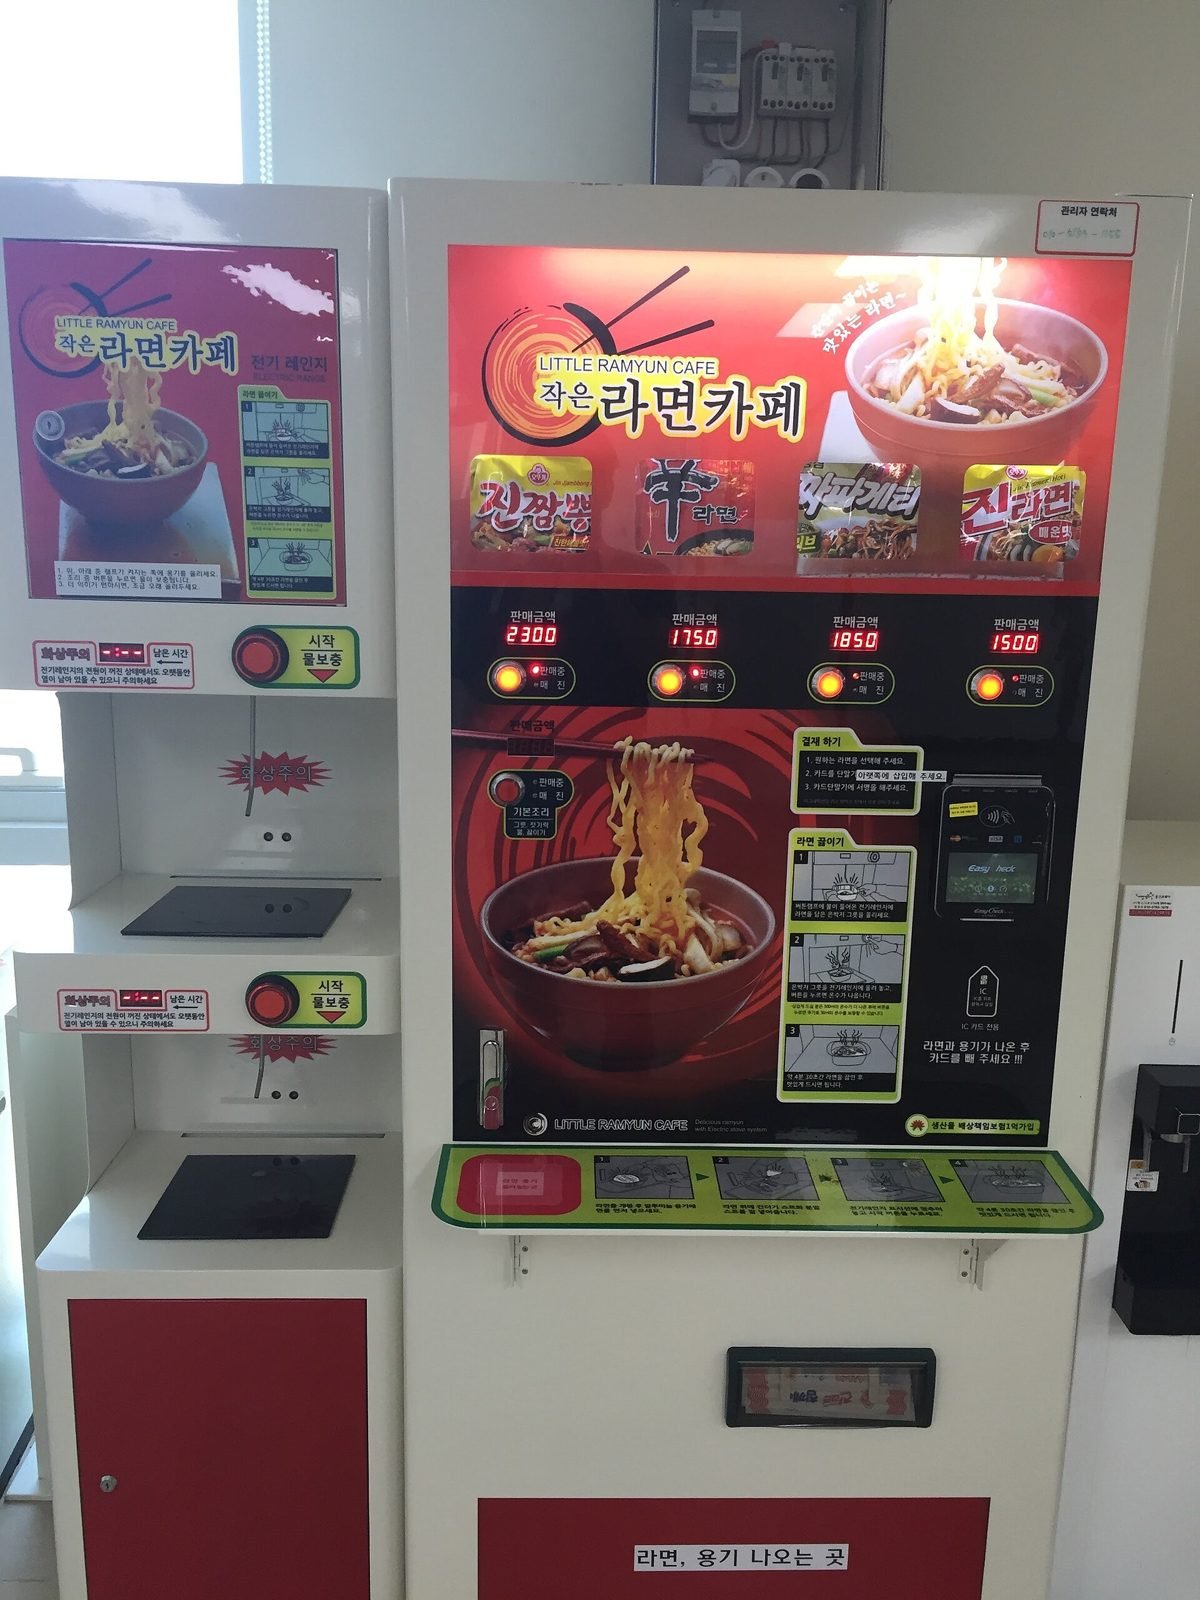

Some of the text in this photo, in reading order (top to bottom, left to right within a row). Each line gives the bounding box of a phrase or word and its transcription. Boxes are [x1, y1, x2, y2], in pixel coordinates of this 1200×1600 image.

[1061, 205, 1118, 217] 관리자 연락처
[57, 318, 175, 331] LITTLE RAMYUN CAFE
[59, 332, 235, 372] 작은 라면카페
[251, 355, 328, 373] 전기 레인지
[539, 356, 716, 376] LITTLE RAMYUN CAFE
[242, 390, 256, 399] 라면
[539, 377, 802, 437] 작은 라면카페
[961, 482, 1071, 535] 진라면
[692, 504, 738, 526] 라면
[510, 611, 556, 623] 판매금액
[672, 614, 718, 626] 판매금액
[833, 616, 879, 628] 판매금액
[994, 619, 1039, 631] 판매금액
[506, 626, 557, 643] 2300
[672, 629, 718, 646] 1750
[833, 632, 878, 648] 1850
[308, 634, 336, 648] 시작
[992, 635, 1038, 650] 1500
[40, 647, 91, 661] 화상주의
[153, 649, 189, 659] 남은 시간
[302, 652, 343, 667] 물보충
[41, 666, 84, 675] 전기레인지의
[108, 667, 123, 676] 꺼진
[540, 666, 565, 677] 판매중
[700, 669, 725, 679] 판매중
[860, 672, 885, 682] 판매중
[57, 675, 72, 683] 남아
[122, 677, 157, 685] 주의하세요
[1019, 674, 1044, 684] 판매중
[802, 736, 841, 747] 결재 하기
[815, 757, 836, 765] 원하는
[837, 757, 858, 765] 라면을
[860, 757, 881, 765] 선택해
[883, 757, 906, 765] 주세요.
[814, 770, 835, 778] 카드를
[858, 772, 946, 781] 아랫쪽에 삽입해 주세요.
[539, 778, 564, 788] 판매중
[813, 784, 855, 792] 카드단말기에
[857, 784, 877, 792] 서명을
[513, 807, 550, 817] 기본조리
[796, 837, 845, 847] 라면 끓이기
[318, 980, 344, 993] 시작
[64, 995, 111, 1007] 화상주의
[169, 995, 203, 1004] 남은 시간
[311, 996, 350, 1010] 물보충
[923, 1041, 1030, 1052] 라면과 용기가 나온 후
[929, 1054, 961, 1064] 카드를
[965, 1054, 975, 1063] 빼
[979, 1055, 1010, 1064] 주세요
[554, 1119, 689, 1131] LITTLE RAMYUN CAFE
[931, 1121, 955, 1130] 생산물
[637, 1548, 846, 1568] 라면, 용기 나오는 곳
